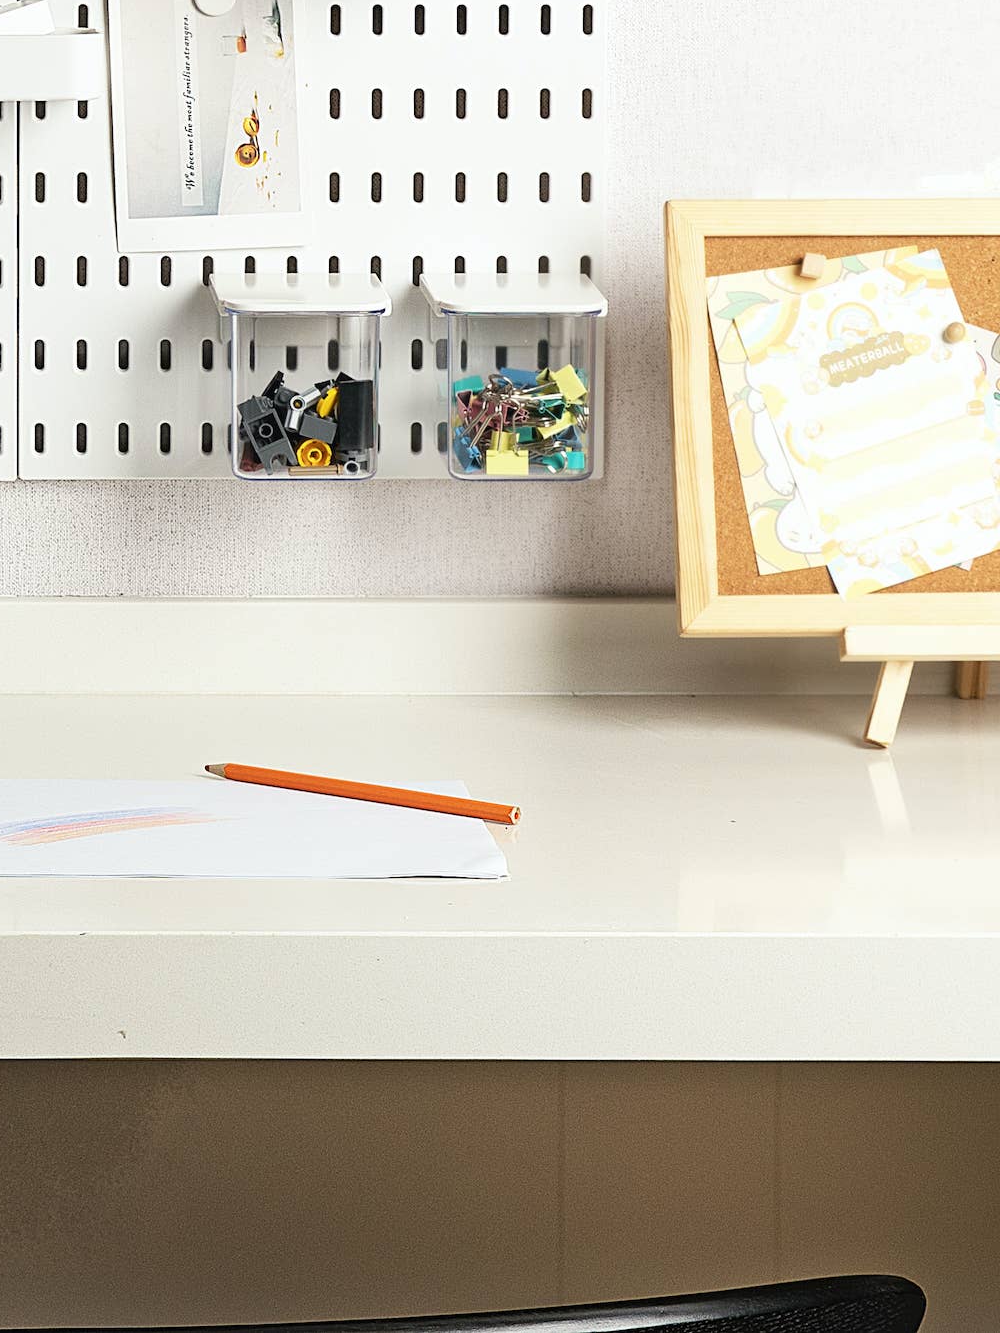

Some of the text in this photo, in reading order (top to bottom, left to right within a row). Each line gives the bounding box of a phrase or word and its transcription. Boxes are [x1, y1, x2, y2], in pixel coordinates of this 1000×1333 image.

[182, 62, 196, 101] familiar
[184, 123, 194, 138] the
[186, 139, 195, 170] become
[184, 171, 195, 190] We
[828, 340, 905, 375] MEATERBALL
